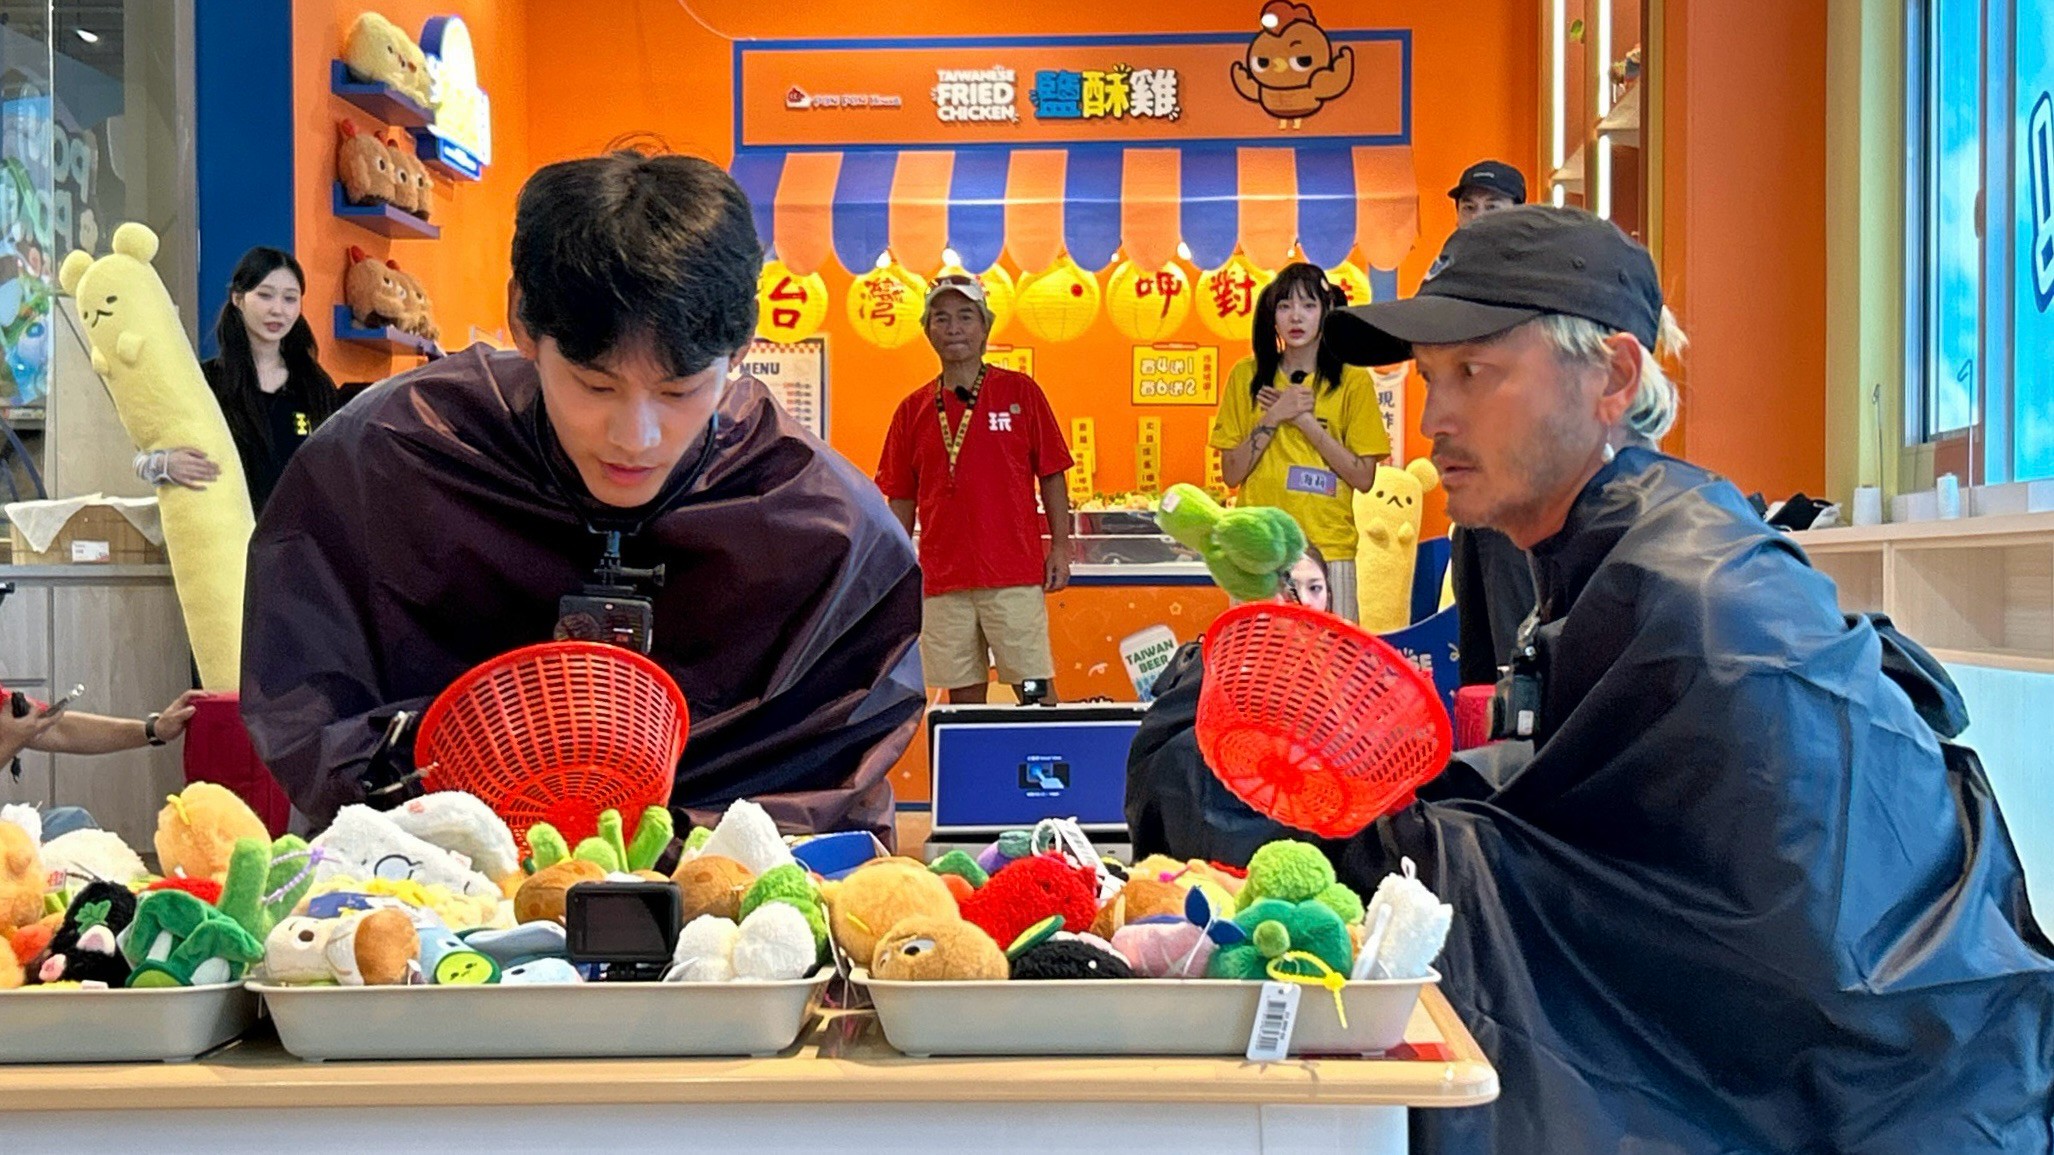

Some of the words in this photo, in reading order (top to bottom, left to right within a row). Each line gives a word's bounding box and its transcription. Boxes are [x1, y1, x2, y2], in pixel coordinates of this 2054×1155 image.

[937, 69, 1015, 82] TAIWANESE
[936, 82, 1015, 106] FRIED
[1035, 69, 1177, 118] 鹽酥雞
[936, 104, 1016, 121] CHICKEN
[740, 362, 780, 375] MENU
[988, 411, 1012, 432] 玩
[1125, 639, 1174, 665] TAIWAN
[1139, 654, 1169, 674] BEER
